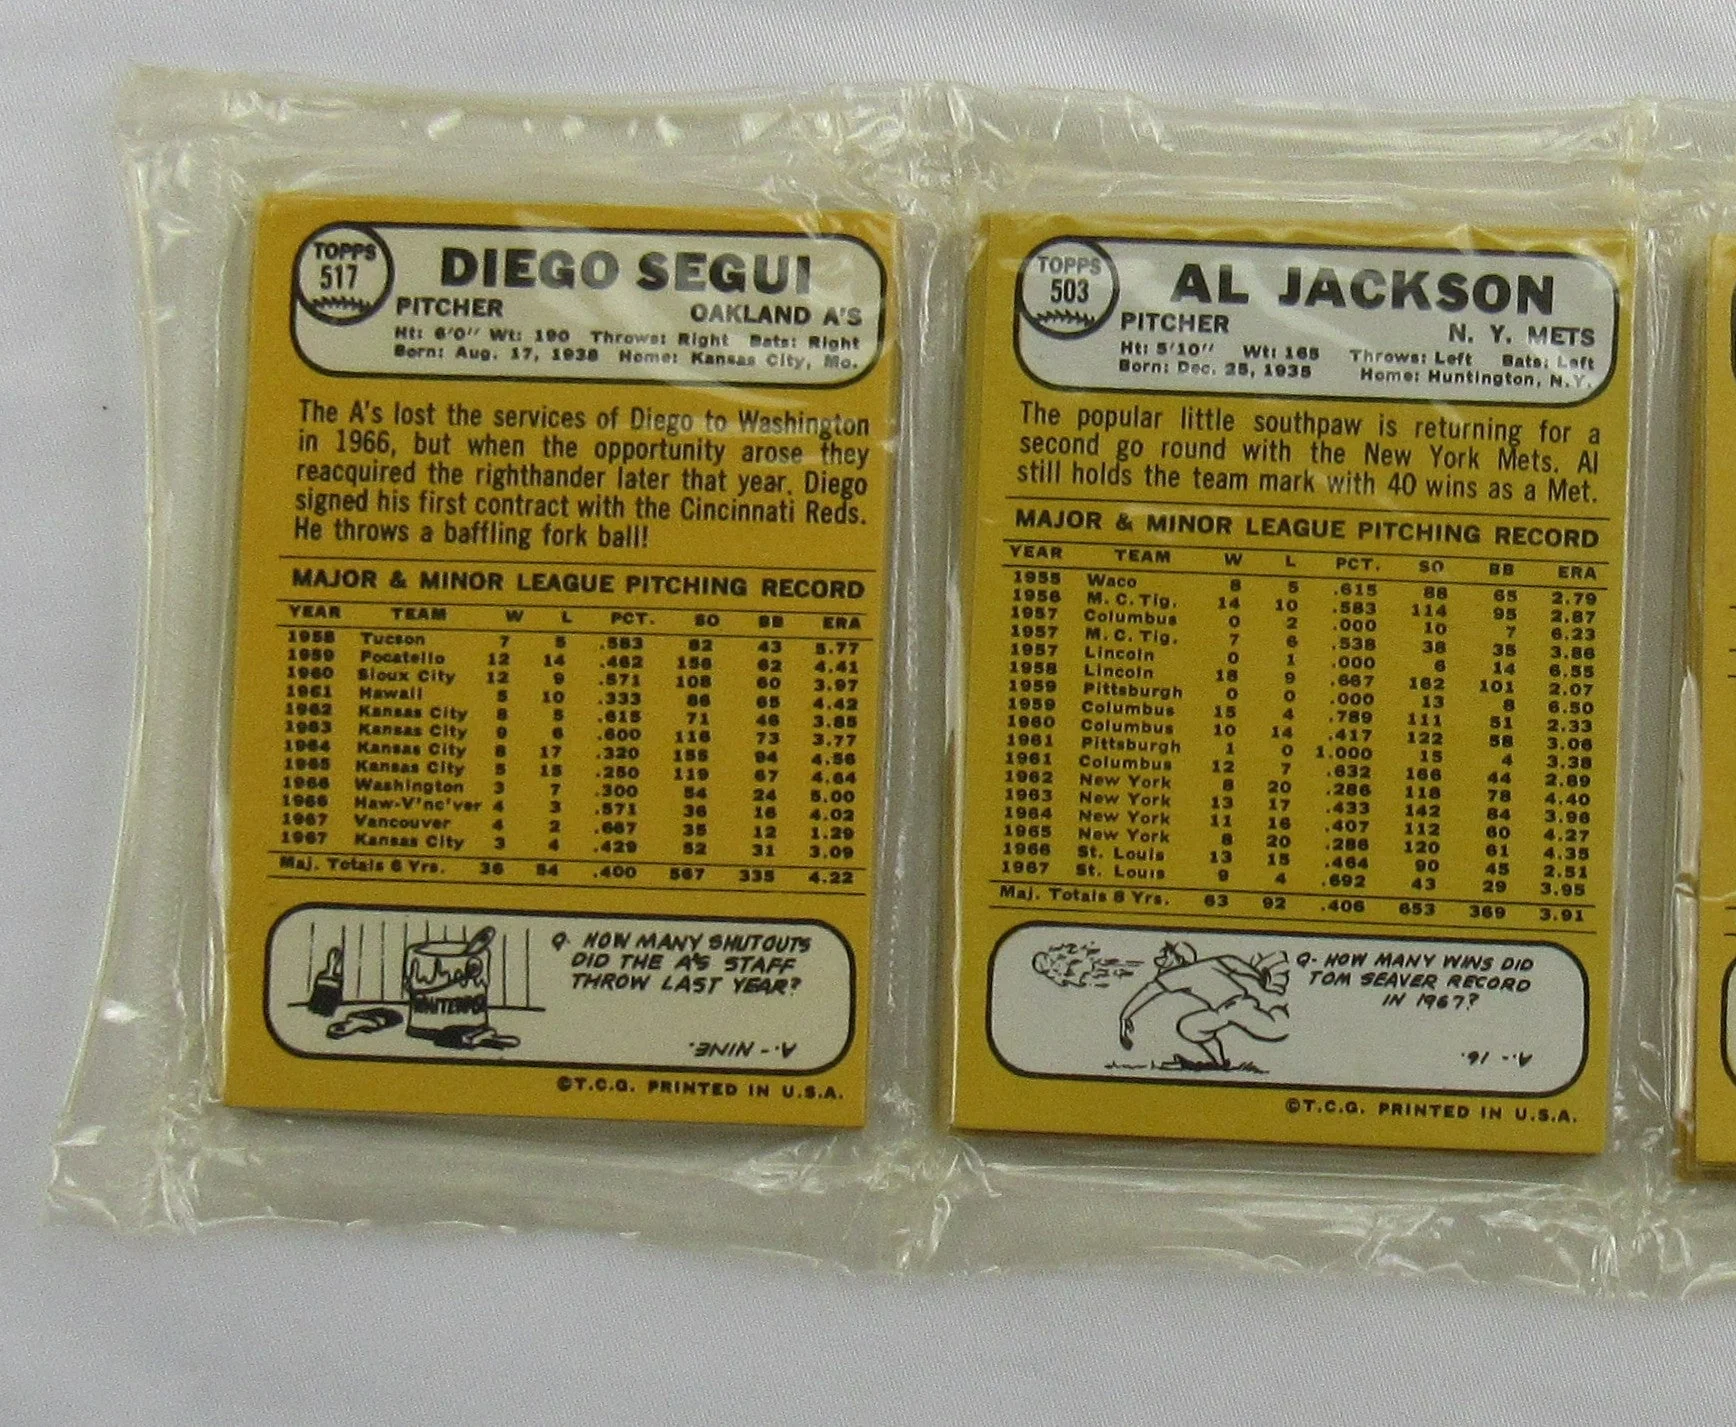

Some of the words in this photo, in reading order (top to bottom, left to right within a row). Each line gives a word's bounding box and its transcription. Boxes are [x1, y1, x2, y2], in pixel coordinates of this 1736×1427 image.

[314, 241, 377, 262] TOPPS
[319, 263, 358, 291] 517
[440, 246, 620, 290] DIEGO
[635, 251, 811, 295] SEGUI
[1037, 255, 1102, 275] TOPPS
[1050, 277, 1089, 305] 503
[1170, 263, 1250, 305] AL
[1278, 266, 1554, 316] JACKSON
[396, 295, 504, 318] PITCHER
[690, 303, 812, 326] OAKLAND
[1120, 311, 1230, 335] PITCHER
[1448, 322, 1474, 344] N.
[1489, 324, 1512, 345] Y.
[1528, 325, 1595, 348] METS
[299, 397, 339, 424] The
[349, 397, 384, 425] A's
[394, 400, 437, 427] lost
[446, 402, 483, 428] the
[493, 404, 587, 430] services
[596, 405, 620, 430] of
[630, 406, 694, 438] Diego
[704, 409, 729, 433] to
[738, 409, 870, 442] Washington
[1019, 431, 1100, 457] second
[1115, 439, 1144, 465] go
[1161, 436, 1227, 461] round
[1242, 437, 1291, 463] with
[1310, 440, 1346, 465] the
[1364, 441, 1412, 467] New
[1429, 444, 1480, 470] York
[1498, 443, 1559, 474] Mets.
[1577, 449, 1599, 475] Al
[1017, 458, 1061, 484] still
[1072, 460, 1132, 487] holds
[1143, 462, 1180, 489] the
[1192, 466, 1248, 492] team
[1259, 468, 1315, 494] mark
[1327, 470, 1375, 496] with
[1387, 471, 1417, 497] 40
[1425, 473, 1477, 500] wins
[1488, 481, 1513, 501] as
[1524, 483, 1536, 502] a
[1548, 476, 1597, 504] Met.
[294, 515, 323, 542] He
[333, 517, 410, 543] throws
[419, 525, 434, 544] a
[444, 519, 533, 551] baffling
[541, 521, 588, 547] fork
[598, 523, 649, 550] ball!
[1015, 508, 1102, 530] MAJOR
[1115, 512, 1133, 532] &
[1146, 513, 1233, 536] MINOR
[1246, 517, 1345, 539] LEAGUE
[1358, 521, 1481, 545] PITCHING
[1494, 525, 1600, 549] RECORD
[292, 567, 377, 589] MAJOR
[389, 569, 408, 590] &
[419, 570, 504, 591] MINOR
[517, 572, 615, 594] LEAGUE
[625, 574, 748, 597] PITCHING
[761, 577, 865, 600] RECORD
[1079, 790, 1120, 805] New
[1127, 792, 1171, 808] York
[1211, 795, 1234, 811] 13
[1268, 797, 1291, 812] 17
[571, 951, 611, 969] DID
[620, 953, 665, 971] THE
[724, 955, 797, 975] STAFF
[572, 972, 651, 992] THROW
[661, 974, 724, 995] LAST
[733, 976, 802, 997] YEAR?
[1309, 970, 1352, 987] TOM
[1360, 971, 1438, 991] SEAVER
[1446, 973, 1531, 993] RECORD
[1381, 991, 1407, 1007] IN
[1416, 992, 1480, 1011] 1967?
[1378, 1101, 1470, 1120] PRINTED
[1480, 1105, 1502, 1121] IN
[1515, 1107, 1577, 1124] U.S.A.
